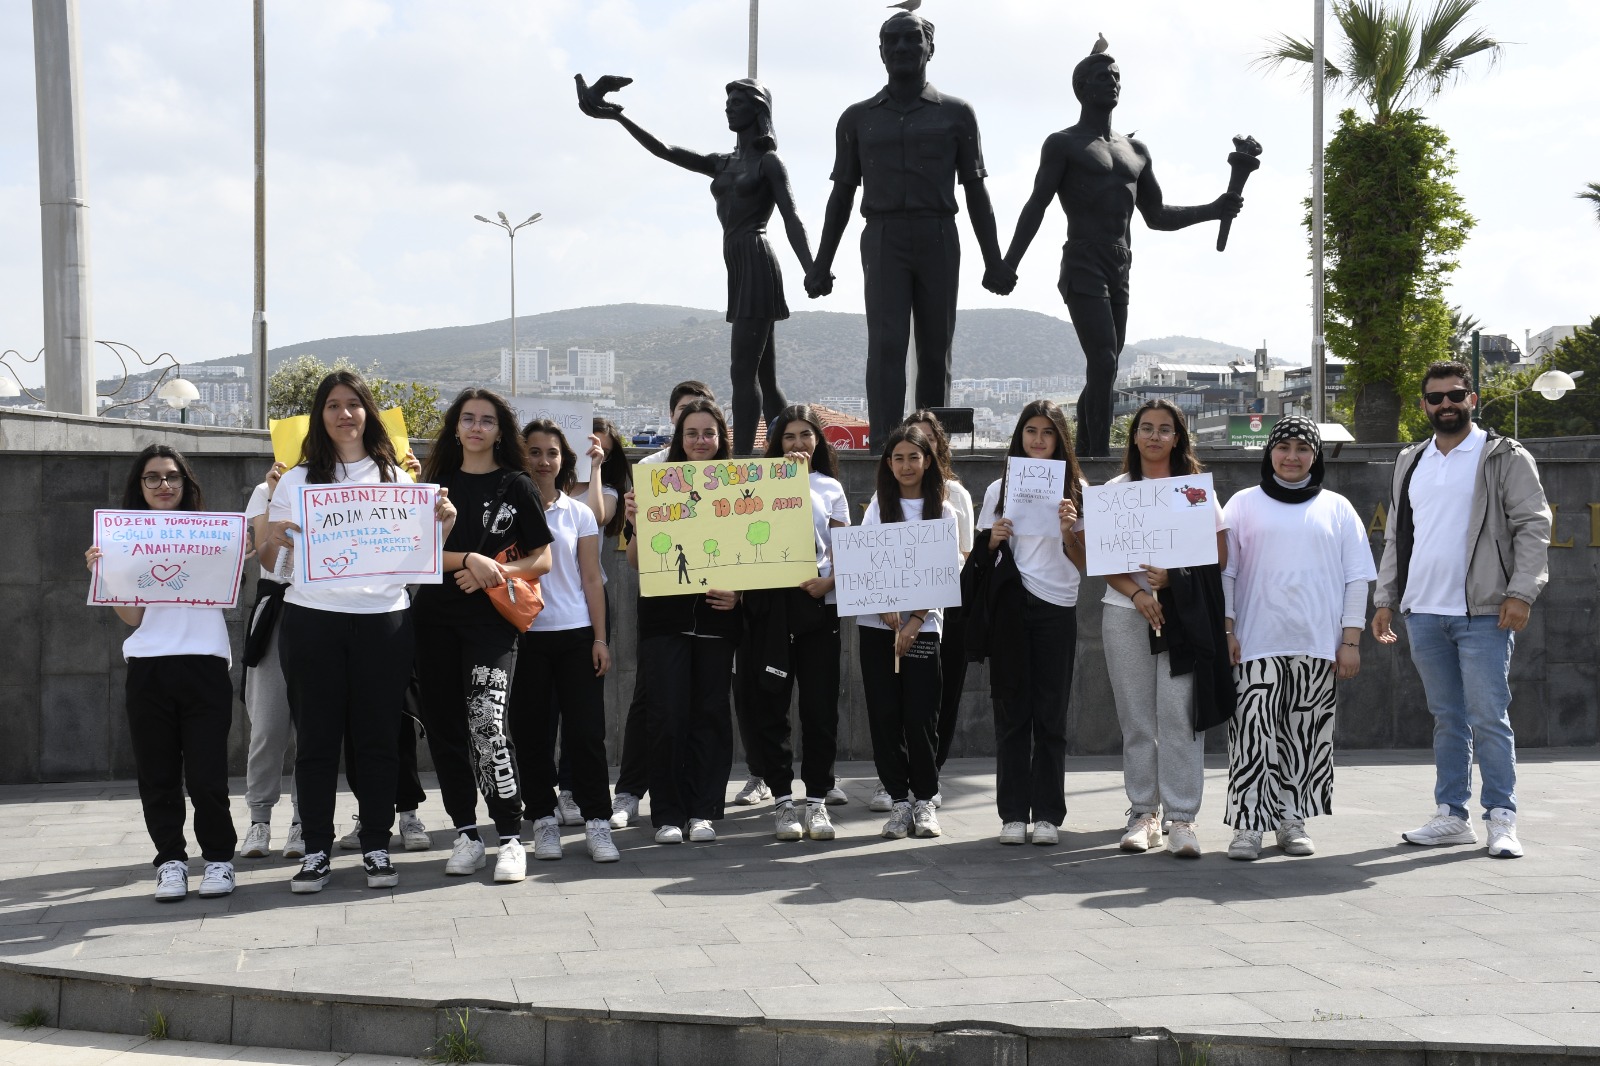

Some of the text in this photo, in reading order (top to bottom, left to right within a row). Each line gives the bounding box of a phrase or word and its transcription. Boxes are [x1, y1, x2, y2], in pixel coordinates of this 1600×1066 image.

[650, 464, 696, 497] KALP
[769, 461, 798, 480] İÇİN
[647, 500, 698, 522] GÜNDE
[772, 496, 803, 512] ADIM
[1097, 485, 1169, 513] SAĞLIK
[322, 507, 408, 528] ADIM ATIN
[1114, 511, 1145, 530] İÇİN
[369, 537, 411, 545] HAREKET
[837, 521, 956, 550] HAREKETSİZLİK
[1100, 528, 1179, 554] HAREKET
[131, 543, 222, 556] ANAHTARIDIR
[1126, 551, 1157, 572] ET
